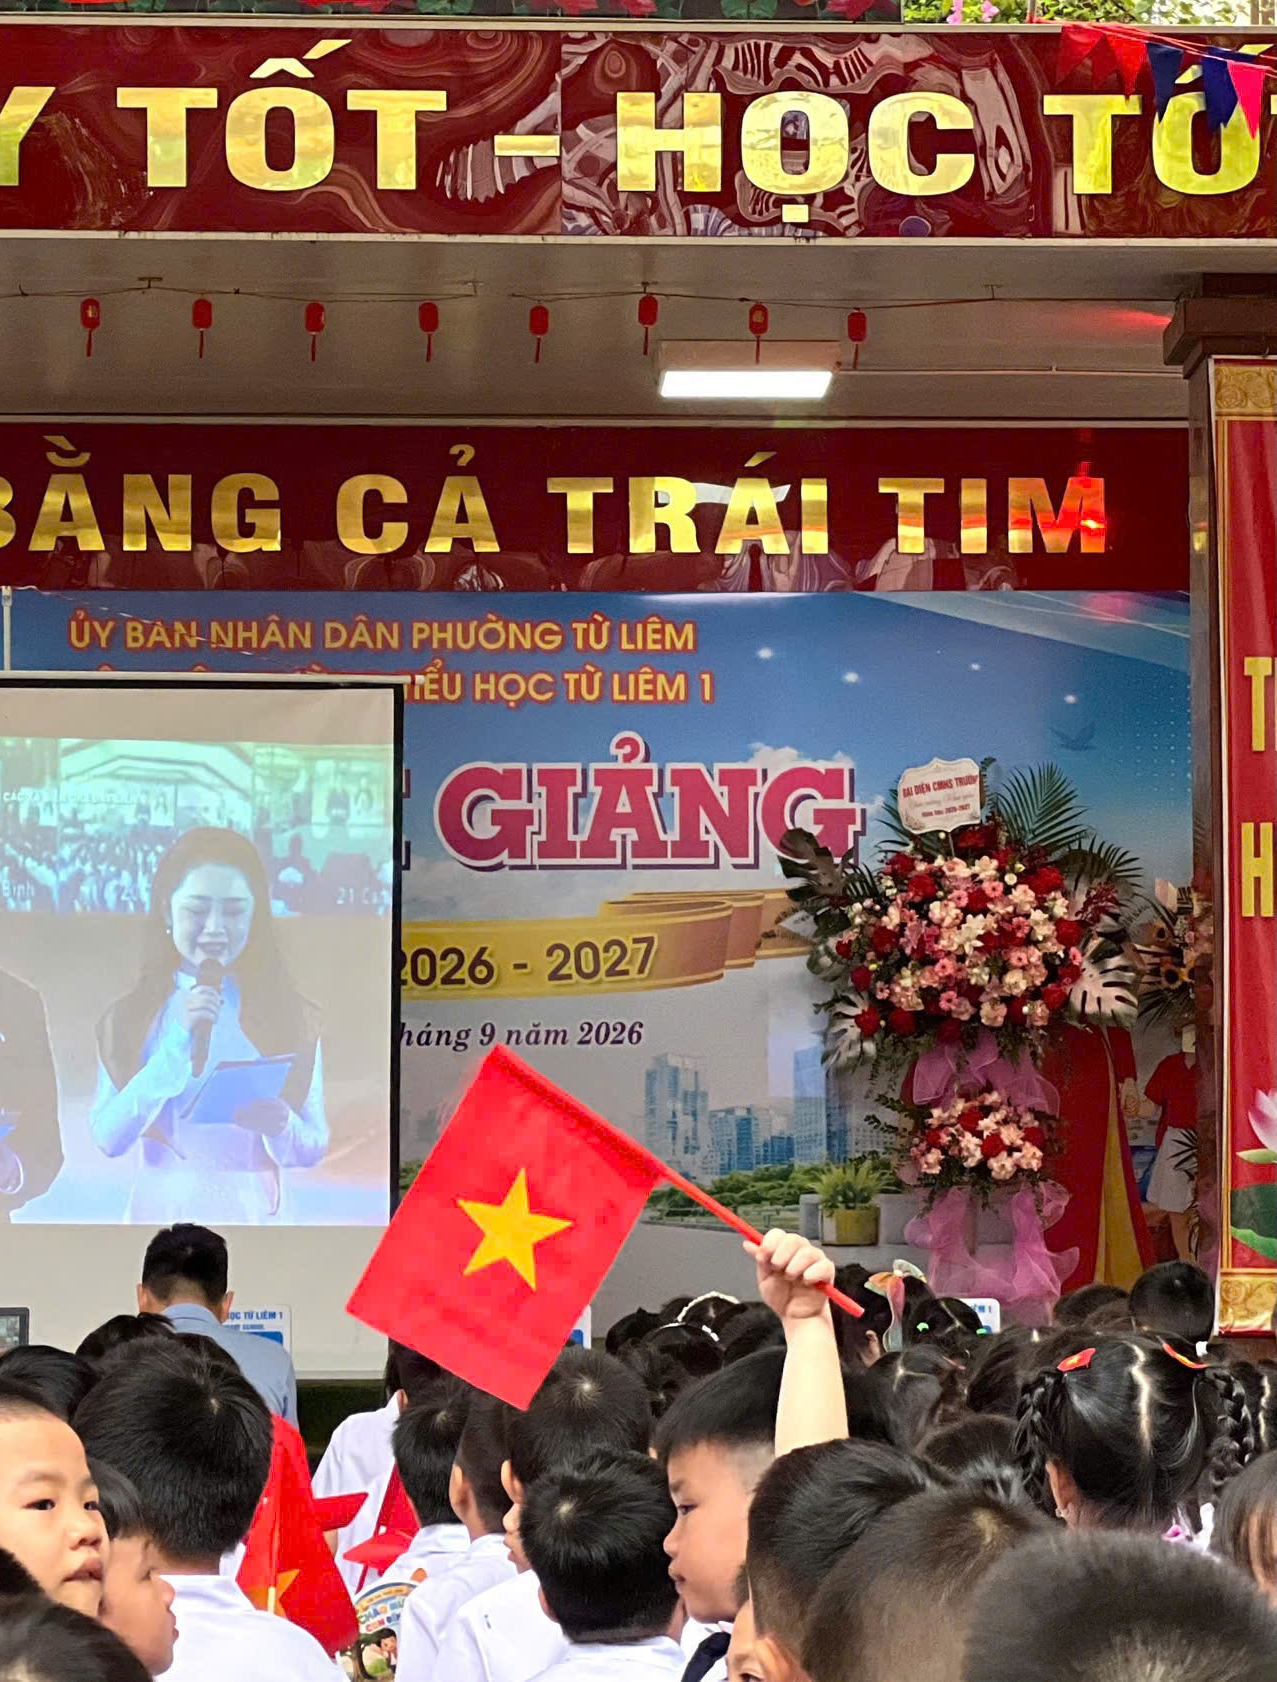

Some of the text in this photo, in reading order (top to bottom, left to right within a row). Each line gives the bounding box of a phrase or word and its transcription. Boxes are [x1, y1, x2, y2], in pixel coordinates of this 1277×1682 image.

[116, 38, 448, 192] TỐT
[494, 135, 561, 158] -
[616, 91, 975, 223] HỌC
[1043, 44, 1277, 195] TỐ
[336, 444, 501, 555] CẢ
[546, 452, 829, 555] TRÁI
[878, 476, 1107, 555] TIM
[70, 608, 116, 649] ỦY
[210, 614, 312, 649] NHÂN
[324, 615, 401, 649] DÂN
[411, 612, 563, 651] PHƯỜNG
[572, 612, 611, 650] TỪ
[621, 616, 695, 651] LIÊM
[404, 658, 712, 708] IỂU HỌC TỪ LIÊM 1
[433, 731, 865, 868] GIẢNG
[401, 946, 495, 987] 026
[545, 936, 657, 982] 2027
[479, 1022, 496, 1046] 9
[506, 1023, 568, 1047] năm
[576, 1021, 644, 1046] 2026
